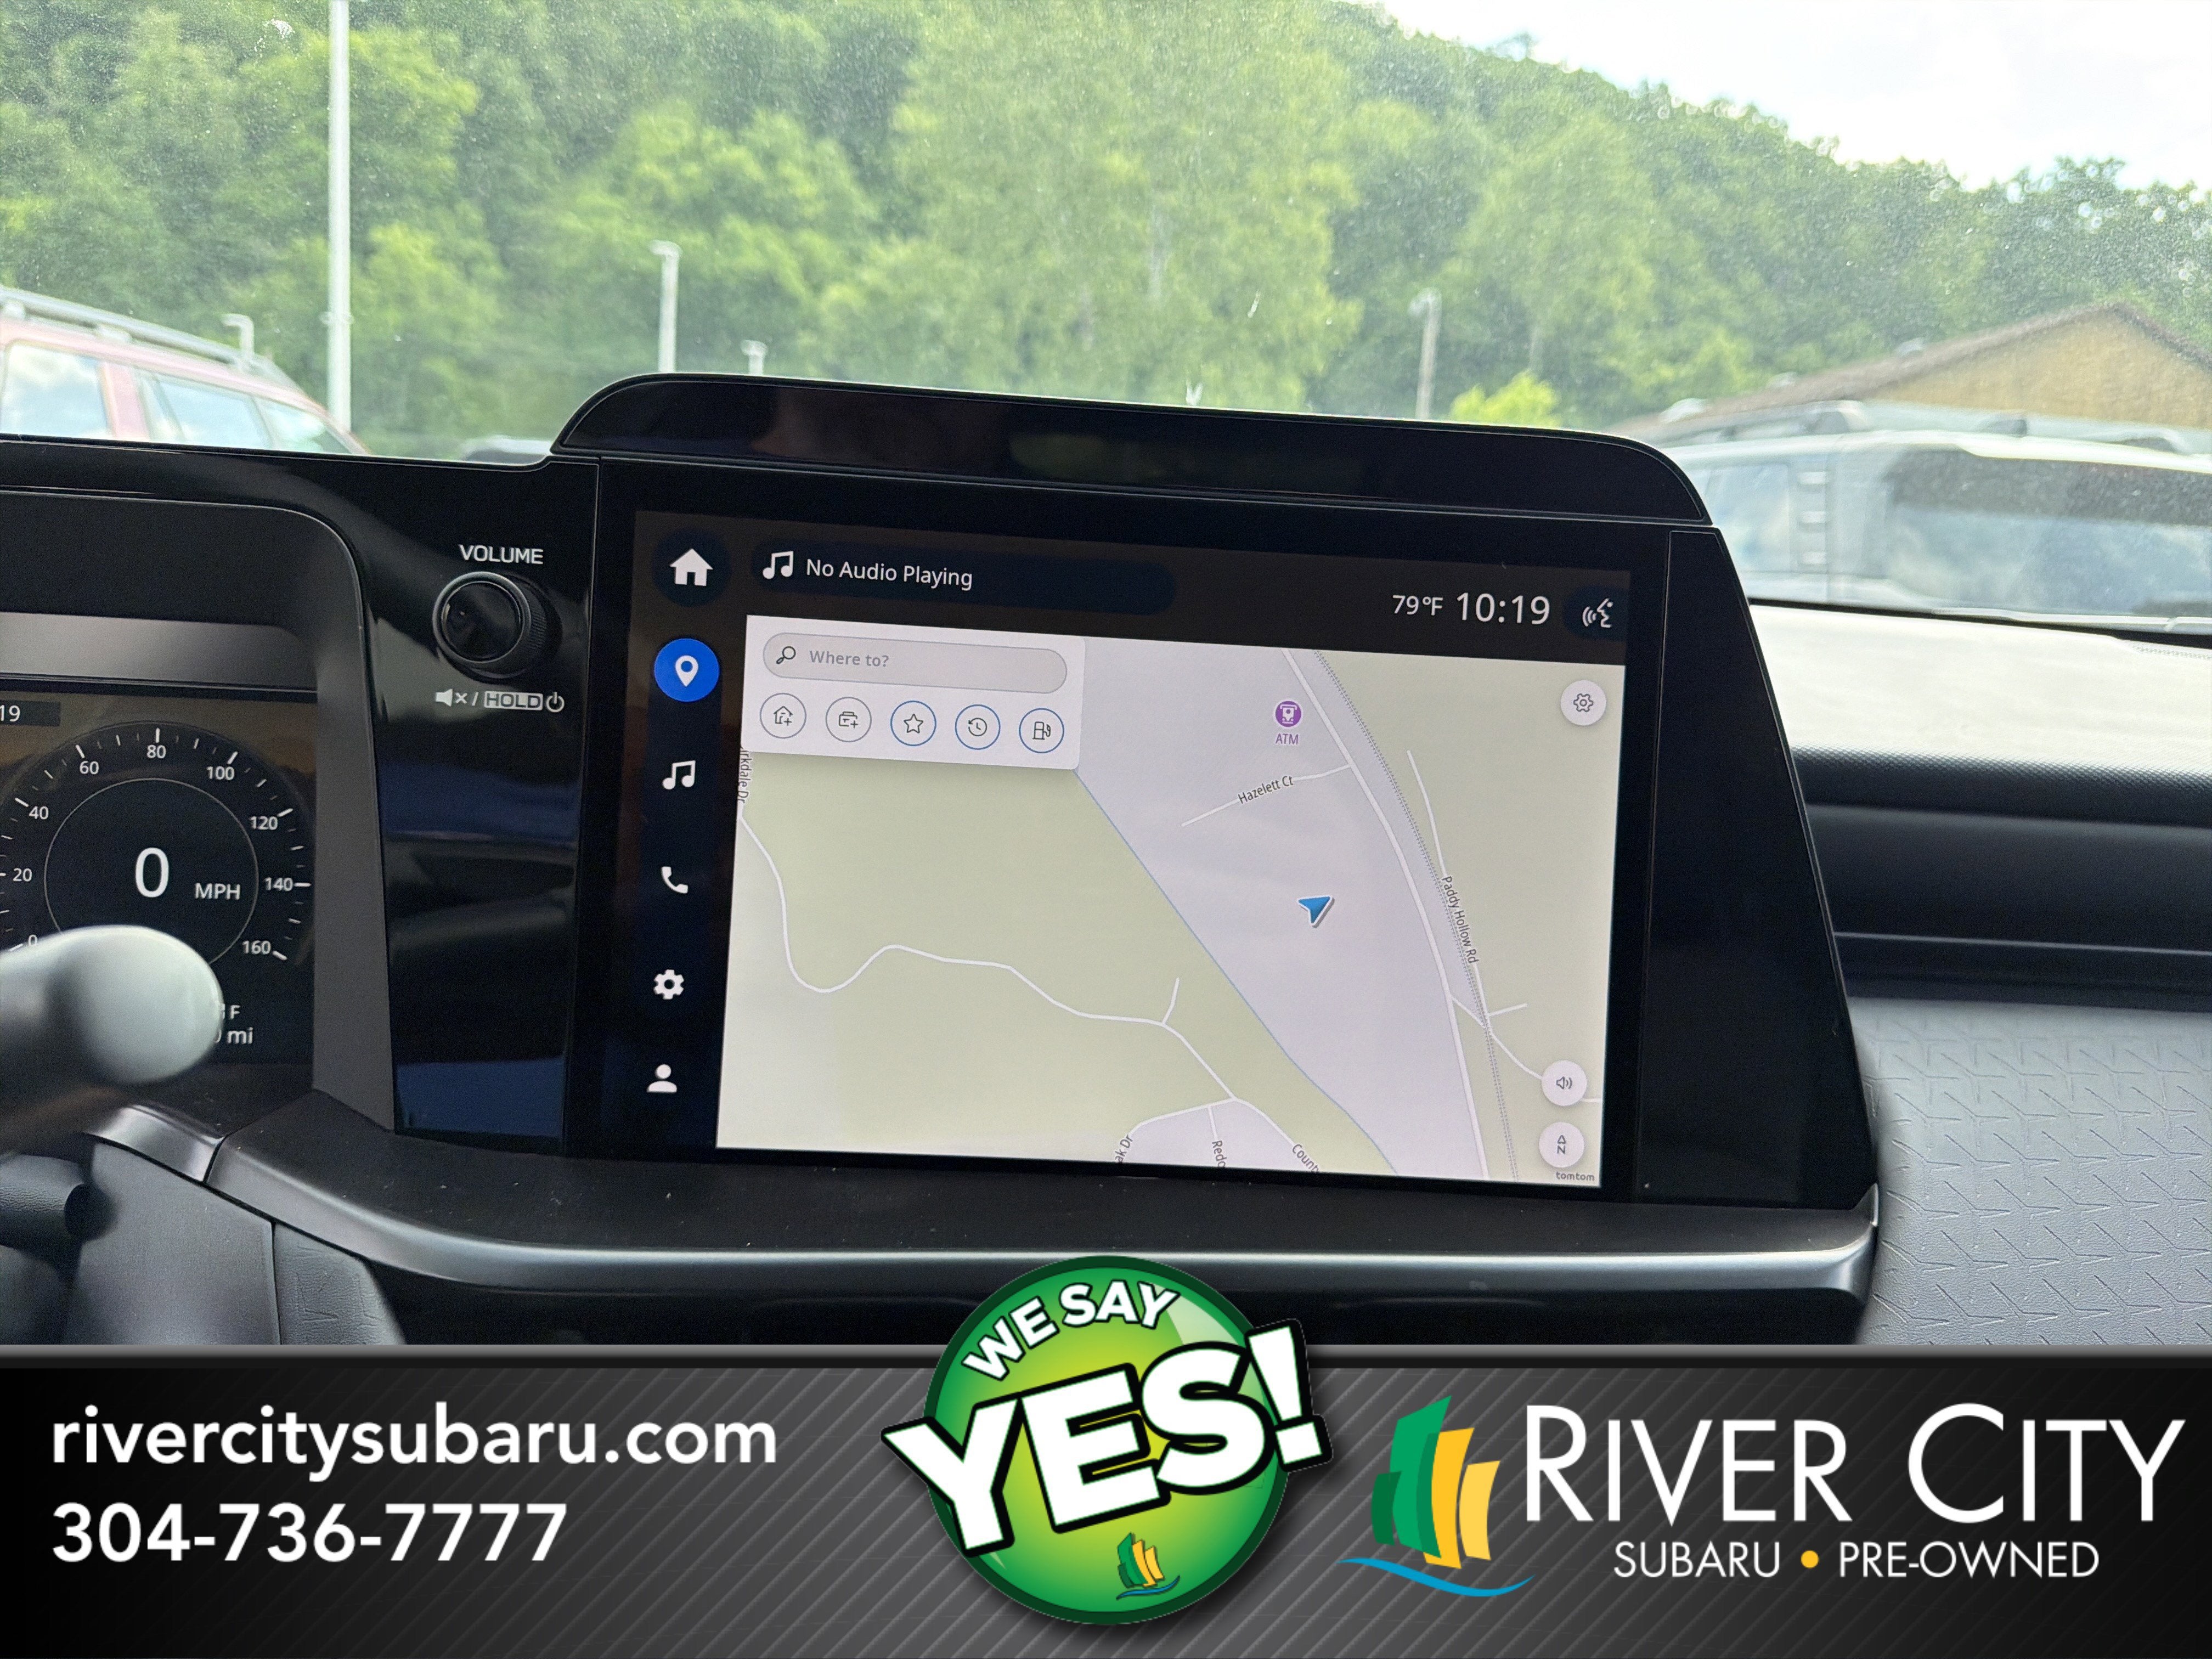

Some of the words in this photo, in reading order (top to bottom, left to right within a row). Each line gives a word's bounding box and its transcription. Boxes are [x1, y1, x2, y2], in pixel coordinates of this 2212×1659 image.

[459, 544, 544, 565] VOLUME
[806, 558, 834, 577] No
[839, 562, 897, 581] Audio
[904, 566, 972, 591] Playing
[1392, 595, 1443, 616] 79°F
[1457, 592, 1550, 624] 10:19
[809, 650, 861, 665] Where
[865, 654, 889, 668] to?
[486, 692, 541, 708] HOLD
[1275, 733, 1299, 745] ATM
[146, 744, 166, 759] 80
[80, 760, 99, 775] 60
[207, 766, 235, 781] 100
[738, 746, 753, 787] irkdale
[1238, 783, 1281, 804] Hazelett
[1282, 775, 1294, 787] Ct
[737, 791, 749, 804] Dr
[29, 806, 49, 820] 40
[250, 816, 278, 830] 120
[13, 867, 32, 882] 20
[135, 847, 169, 898] 0
[195, 882, 240, 900] MPH
[265, 877, 293, 891] 140
[1442, 876, 1460, 908] Paddy
[1454, 910, 1471, 947] Hollow
[1465, 949, 1479, 963] Rd
[243, 940, 271, 955] 160
[227, 1027, 253, 1044] mi
[1119, 1134, 1133, 1148] Dr
[1556, 1171, 1595, 1181] tomtom
